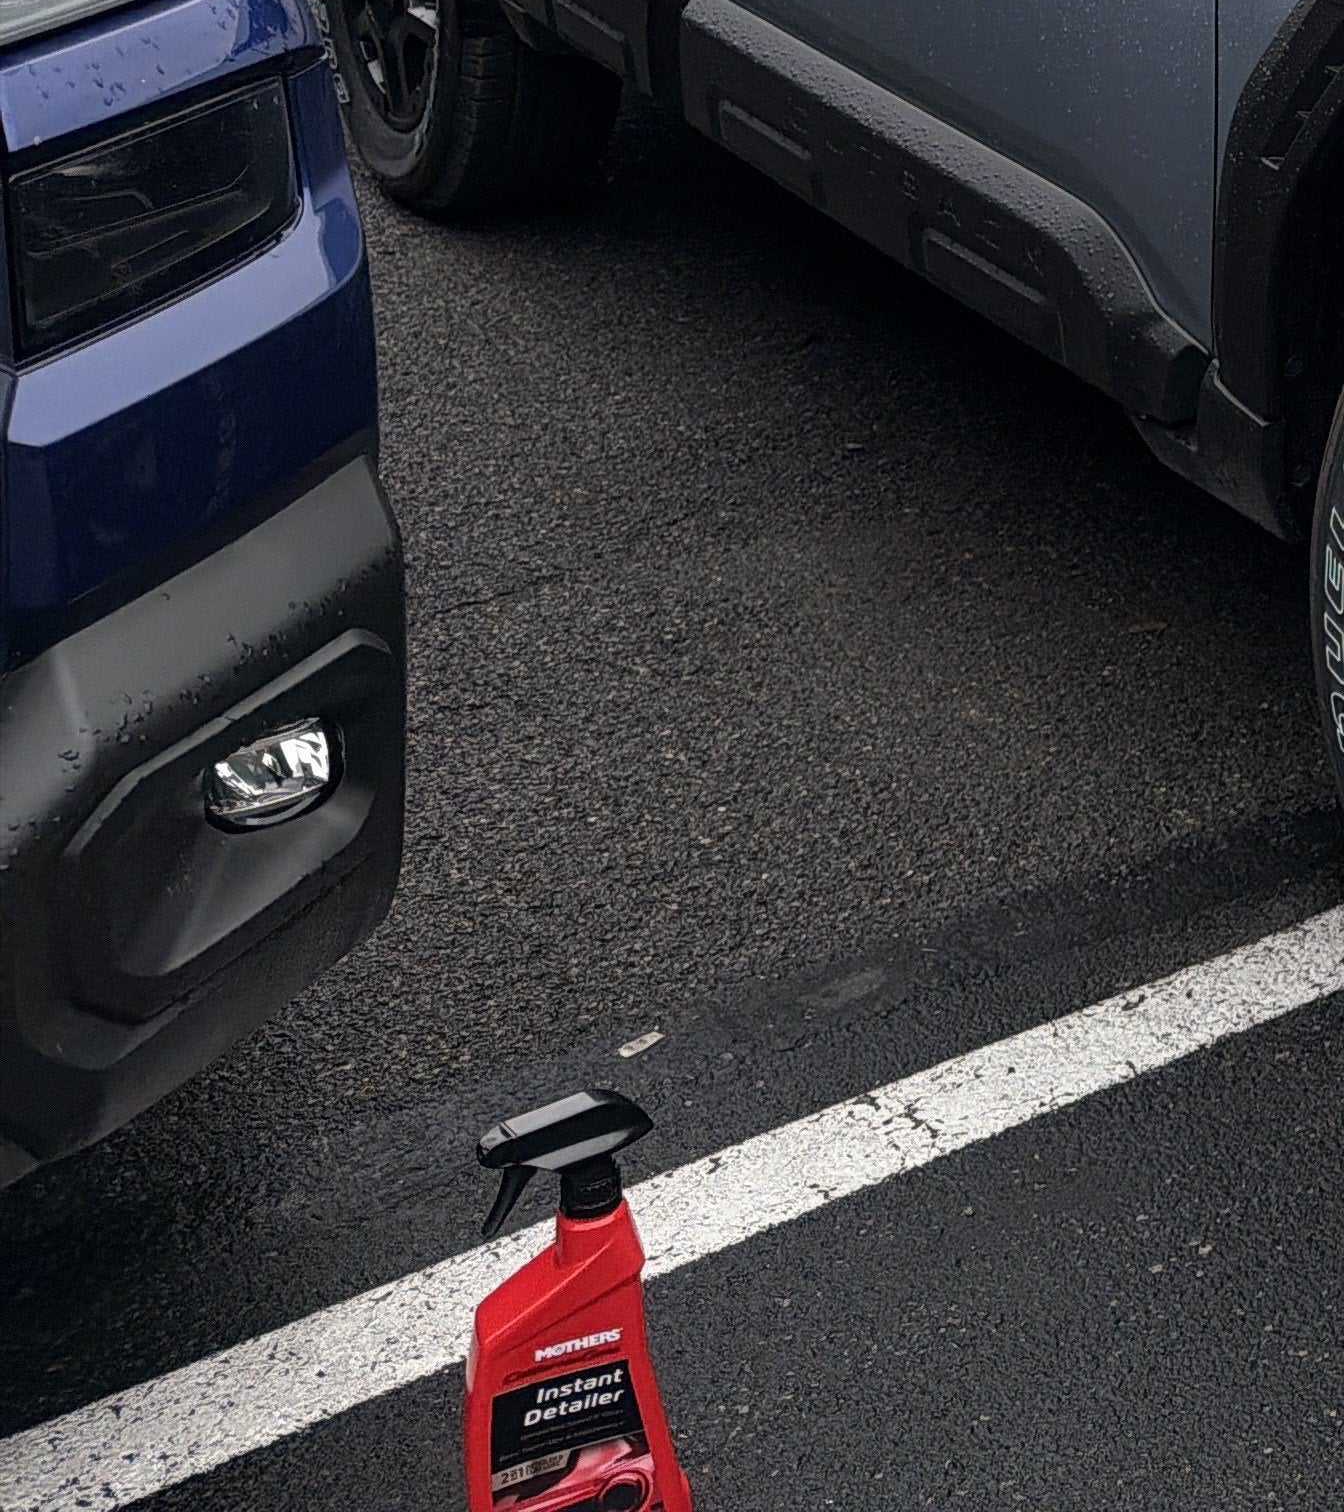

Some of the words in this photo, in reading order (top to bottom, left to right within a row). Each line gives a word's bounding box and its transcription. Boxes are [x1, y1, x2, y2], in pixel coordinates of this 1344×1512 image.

[534, 1328, 622, 1362] MOTHERS
[536, 1367, 624, 1404] Instant
[523, 1388, 625, 1427] Detailer
